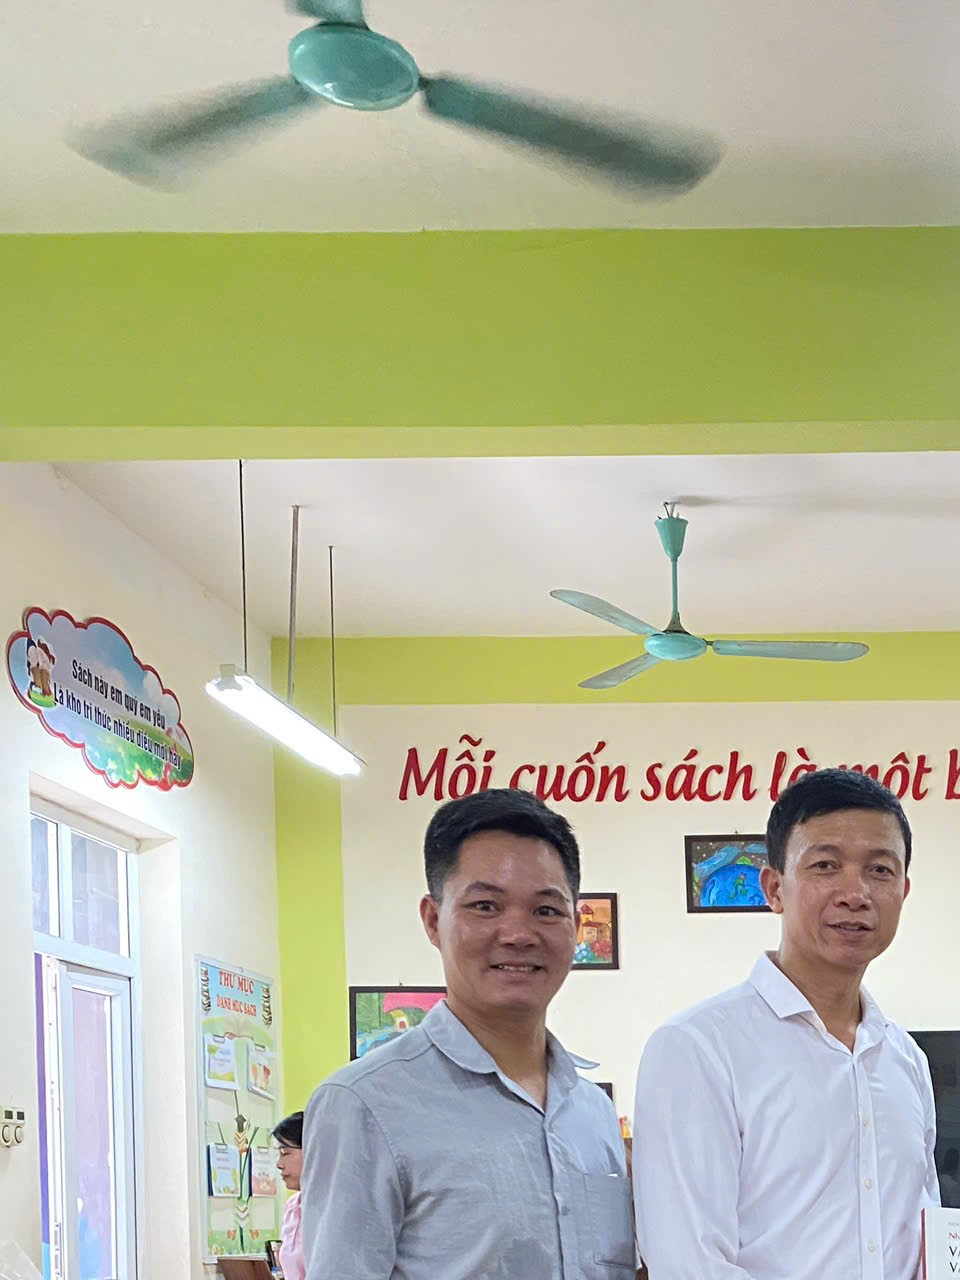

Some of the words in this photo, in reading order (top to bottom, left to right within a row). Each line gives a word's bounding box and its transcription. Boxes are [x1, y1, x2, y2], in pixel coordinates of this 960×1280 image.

[66, 689, 81, 715] kho
[72, 659, 92, 688] Sách
[110, 685, 122, 705] em
[140, 702, 152, 722] em
[399, 734, 496, 801] Mỗi
[509, 741, 629, 802] cuốn
[640, 749, 757, 802] sách
